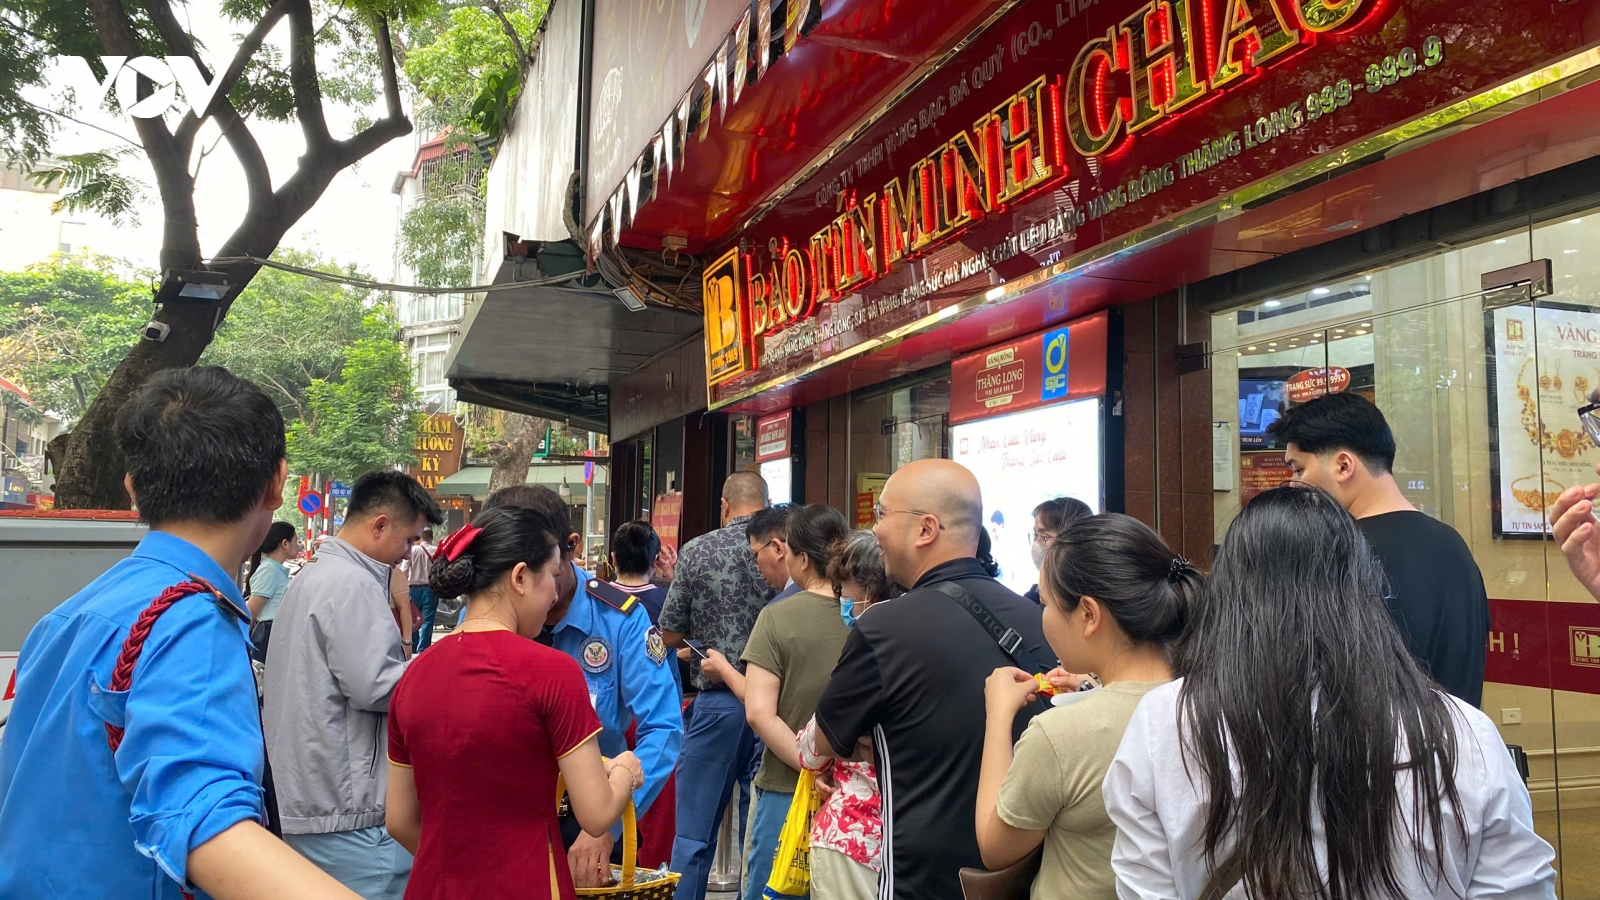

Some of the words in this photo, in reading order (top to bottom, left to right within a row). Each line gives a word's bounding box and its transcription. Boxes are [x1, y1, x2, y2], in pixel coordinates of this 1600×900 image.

[840, 165, 854, 189] TY
[855, 142, 883, 178] TNHH
[919, 95, 947, 130] BẠC
[949, 71, 971, 108] ĐÁ
[971, 44, 1004, 90] QUÝ
[1086, 185, 1127, 221] VÀNG
[1128, 163, 1175, 203] RỒNG
[1176, 130, 1242, 180] THĂNG
[1243, 101, 1304, 150] LONG
[750, 237, 806, 337] BẢO
[809, 188, 879, 304] TÍN
[883, 73, 1053, 264] MINH
[1557, 322, 1597, 343] VÀNG
[1573, 349, 1598, 359] TRANG
[977, 373, 1002, 390] THĂNG
[1003, 368, 1023, 384] LONG
[1286, 380, 1304, 392] TRANG
[1304, 378, 1316, 389] SỨC
[422, 453, 442, 472] KỲ
[416, 475, 445, 490] NAM
[1522, 522, 1532, 530] TIN
